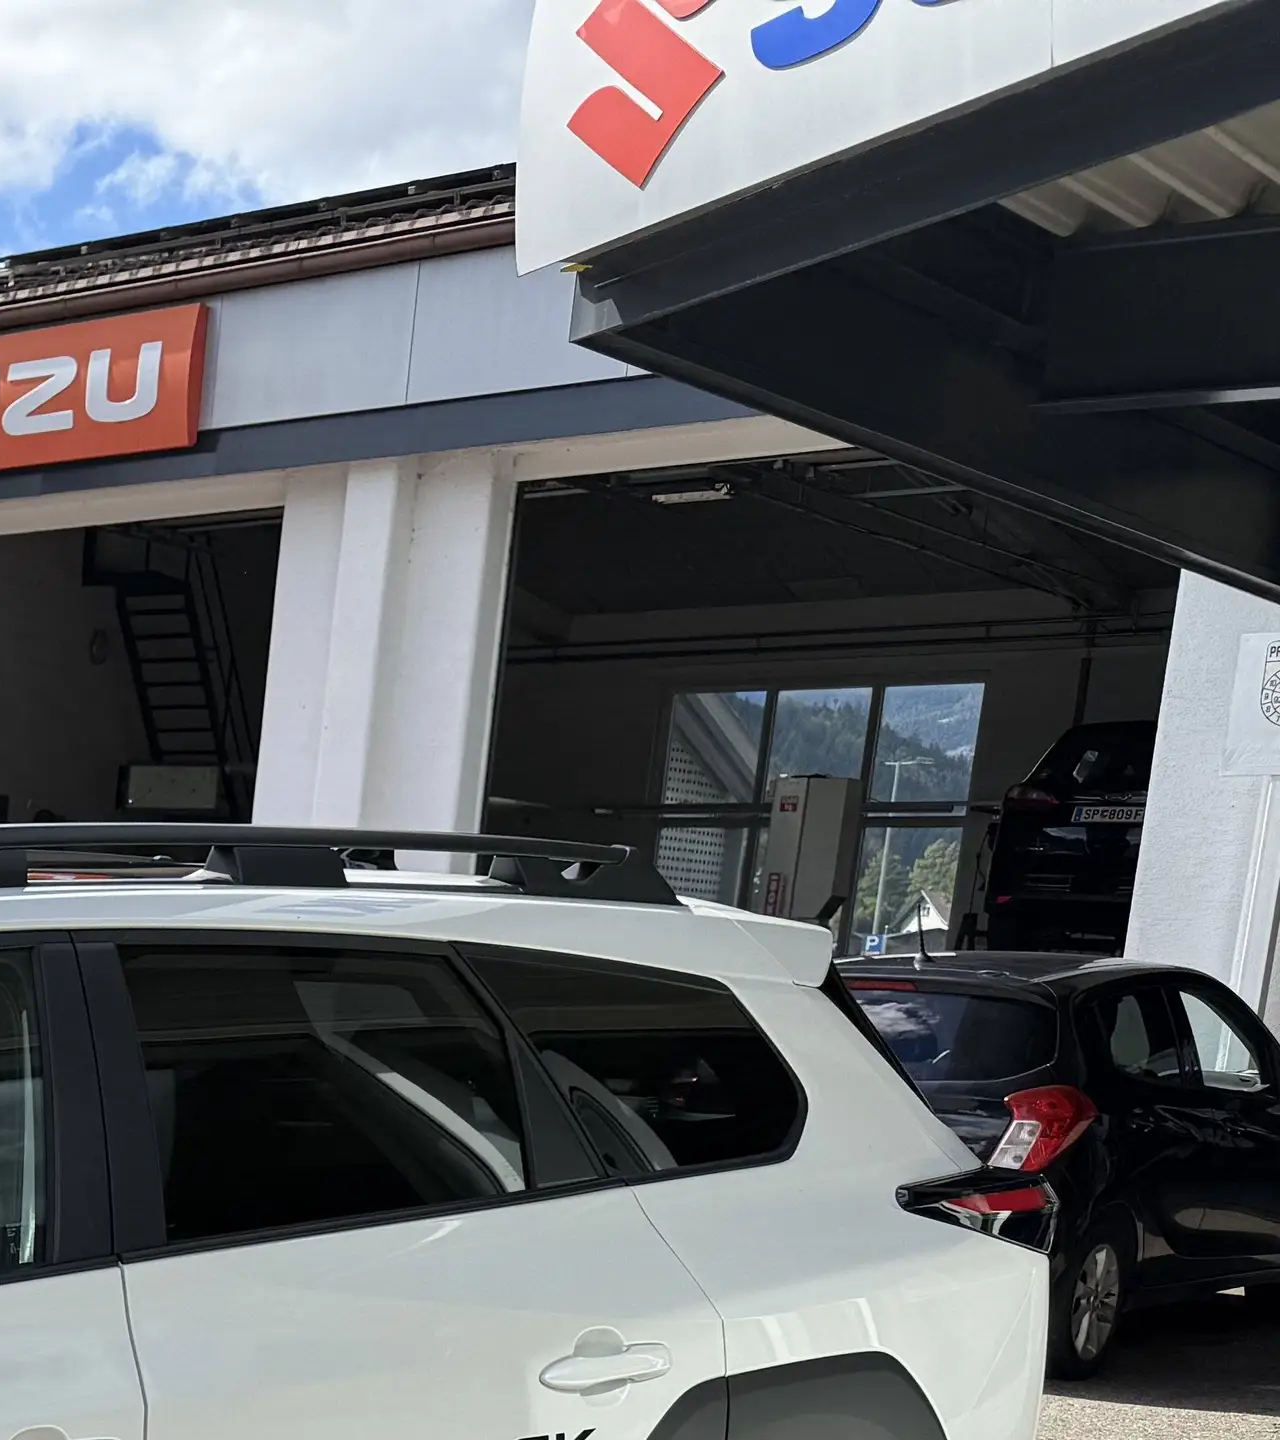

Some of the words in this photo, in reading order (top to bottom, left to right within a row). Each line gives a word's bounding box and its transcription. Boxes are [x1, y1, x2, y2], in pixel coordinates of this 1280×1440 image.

[1083, 808, 1100, 820] SP
[1107, 808, 1133, 820] 809
[865, 934, 880, 951] P
